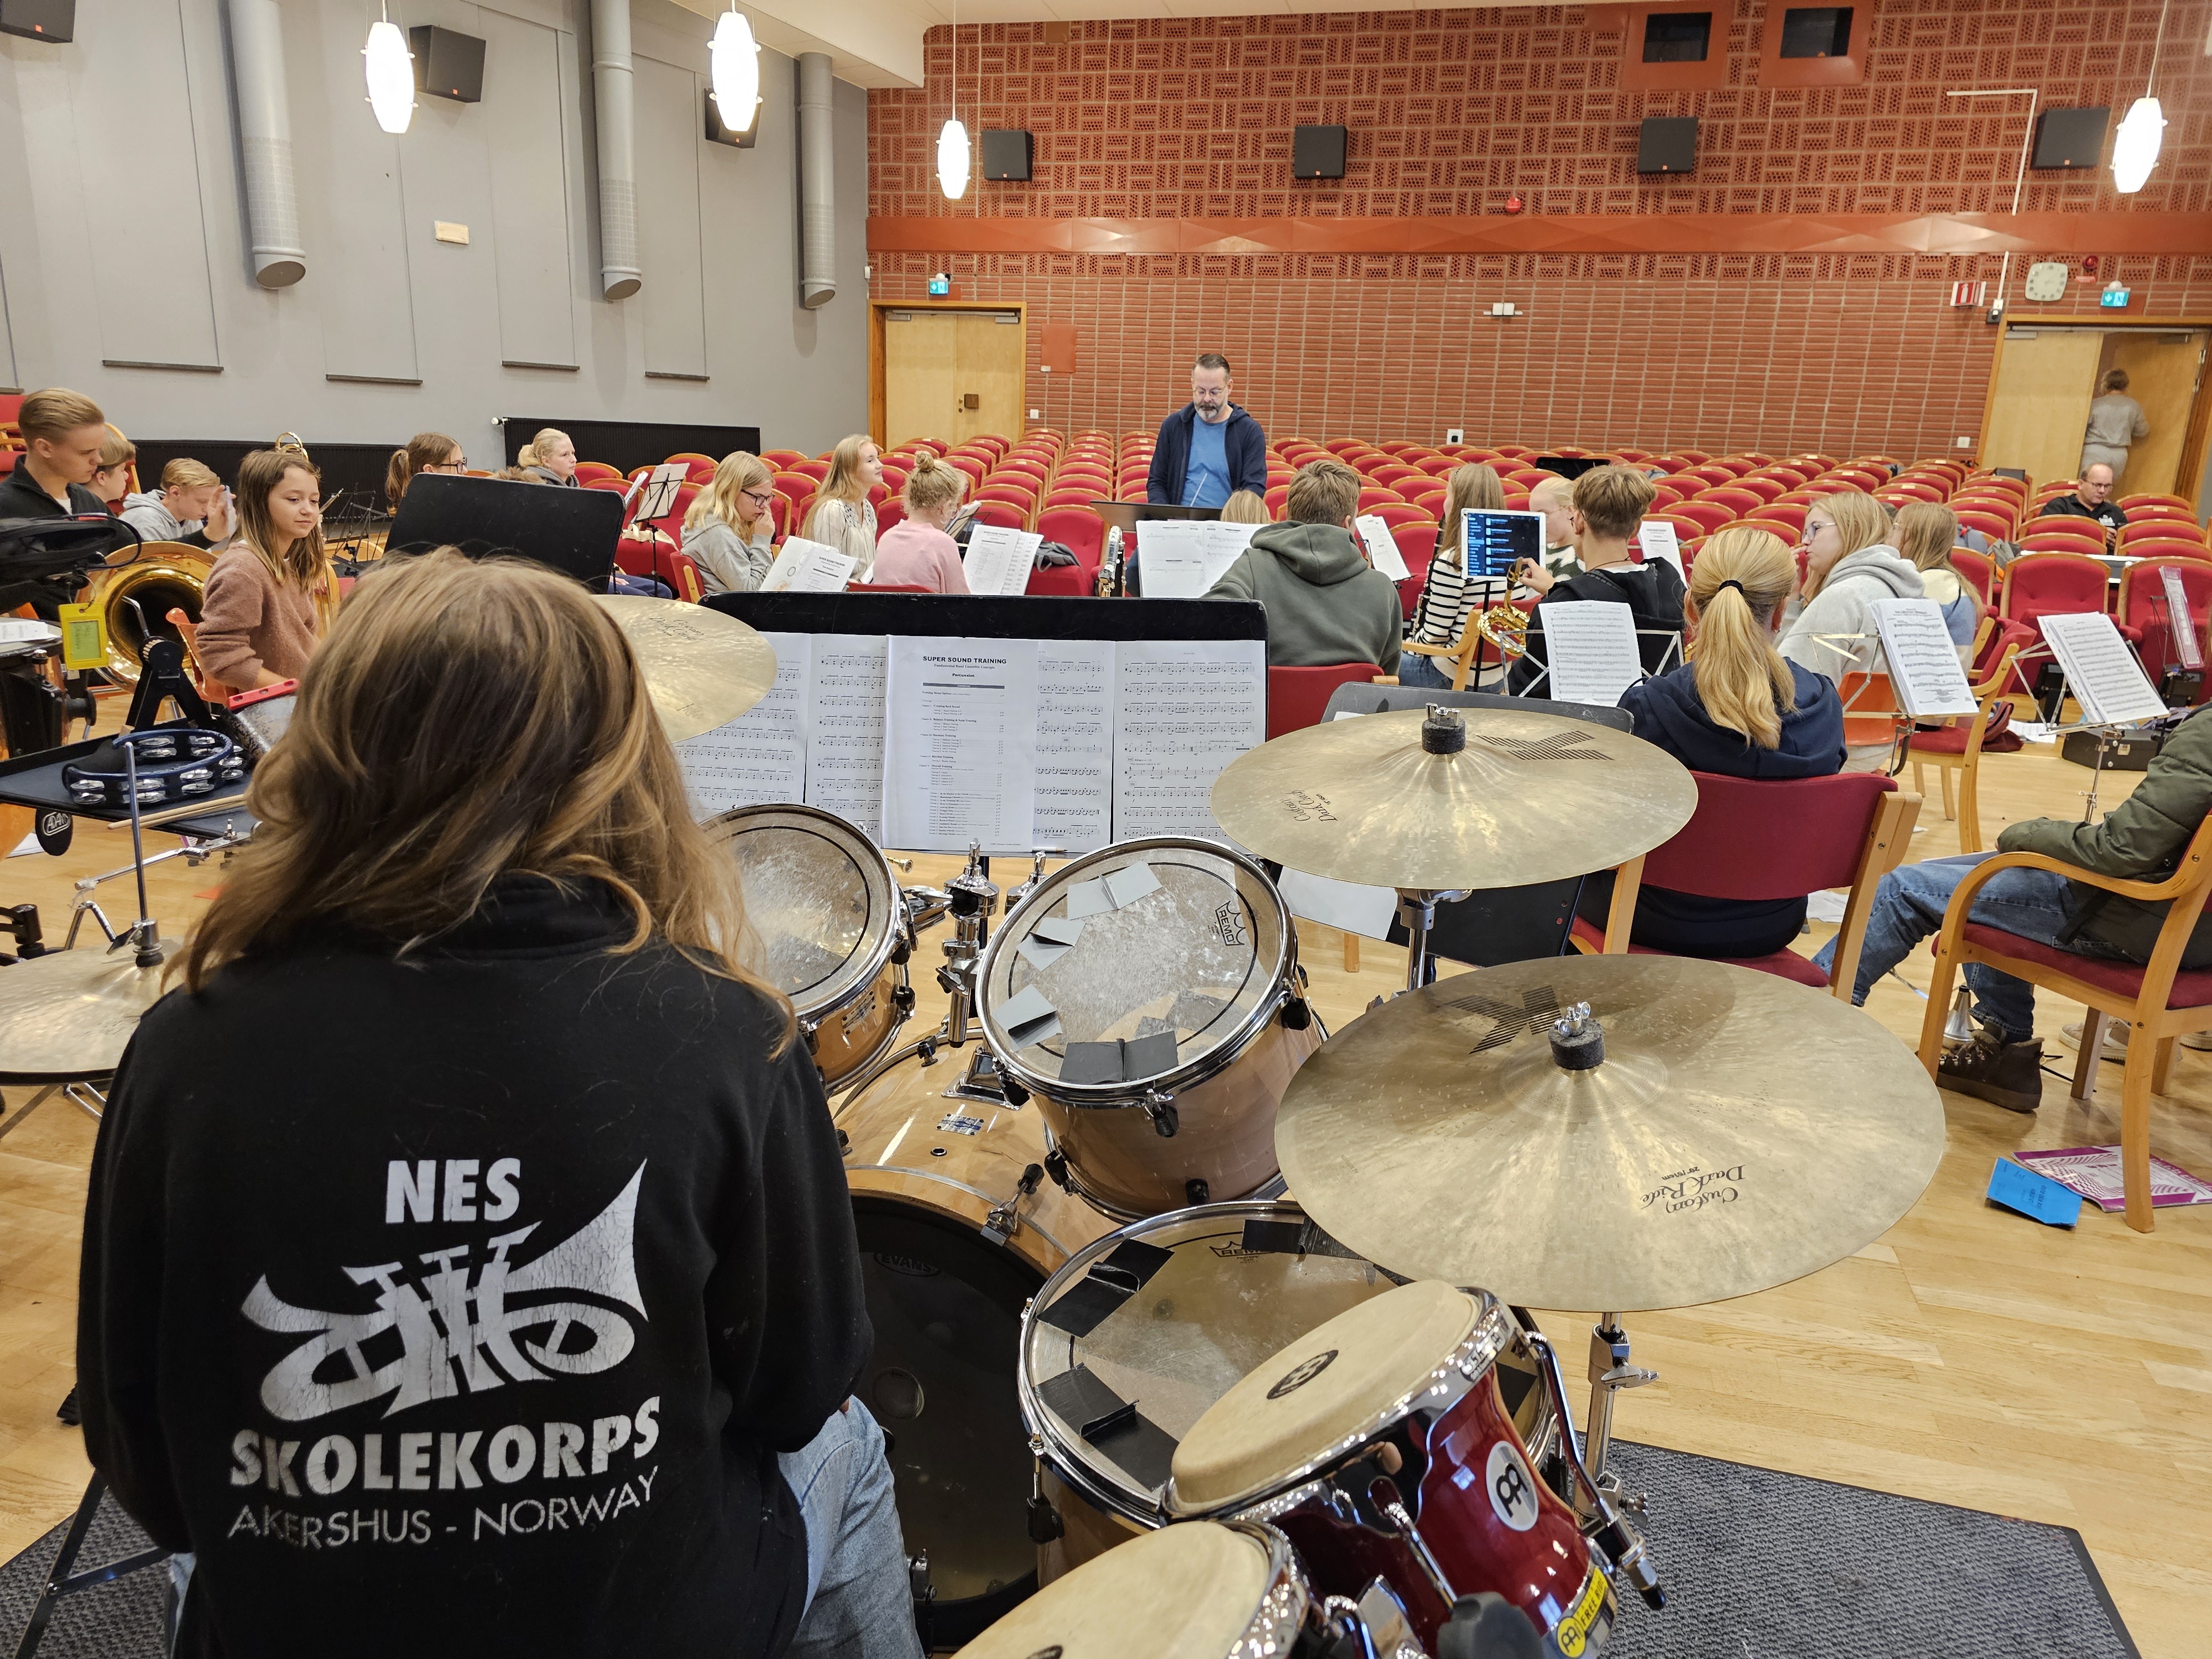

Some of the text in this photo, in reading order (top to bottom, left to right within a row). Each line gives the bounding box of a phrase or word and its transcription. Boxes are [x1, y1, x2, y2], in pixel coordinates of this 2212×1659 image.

[1219, 909, 1234, 942] REMO
[385, 1157, 520, 1223] NES
[1640, 1164, 1746, 1210] Dark Ride
[1666, 1187, 1739, 1213] Custom
[231, 1396, 660, 1498] SKOLEKORPS
[227, 1505, 431, 1549] AKERSHUS
[474, 1465, 659, 1542] NORWAY
[1580, 1600, 1597, 1626] FREE
[1594, 1579, 1604, 1600] RIDE
